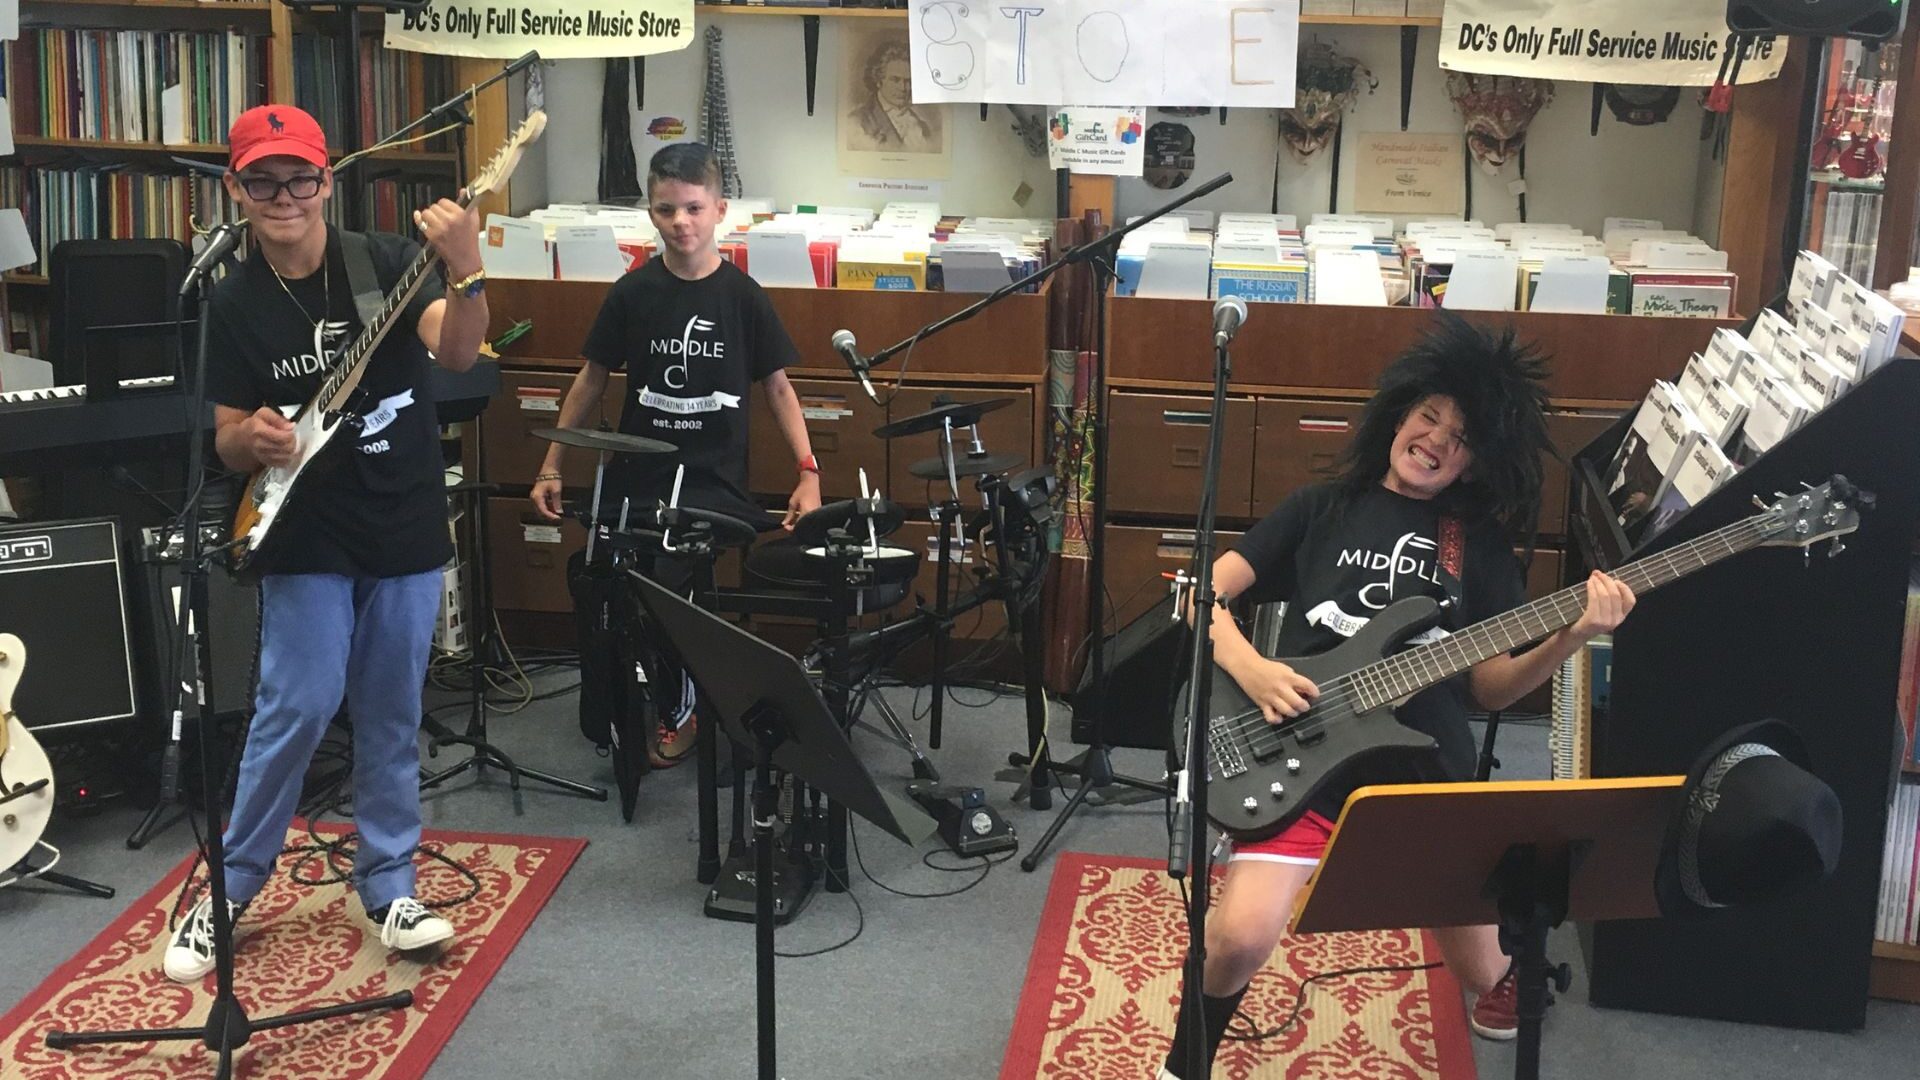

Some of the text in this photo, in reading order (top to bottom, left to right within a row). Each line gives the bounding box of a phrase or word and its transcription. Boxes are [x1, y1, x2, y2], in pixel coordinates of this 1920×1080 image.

[403, 6, 681, 39] DC's Only Full Service Music Store
[1458, 23, 1497, 52] DC's
[1503, 25, 1543, 55] Only
[1550, 28, 1582, 56] Full
[1586, 31, 1656, 59] Service
[1661, 32, 1718, 60] Music
[1075, 133, 1108, 142] GiftCard
[1233, 279, 1297, 292] THE RUSSIAN
[1643, 300, 1677, 312] Music
[1680, 298, 1719, 318] Theory
[272, 350, 336, 380] MID
[664, 365, 684, 389] C
[687, 402, 695, 411] 14
[696, 399, 718, 410] YEARS
[652, 418, 702, 430] est. 2002
[356, 439, 390, 454] 002
[1358, 582, 1390, 609] C
